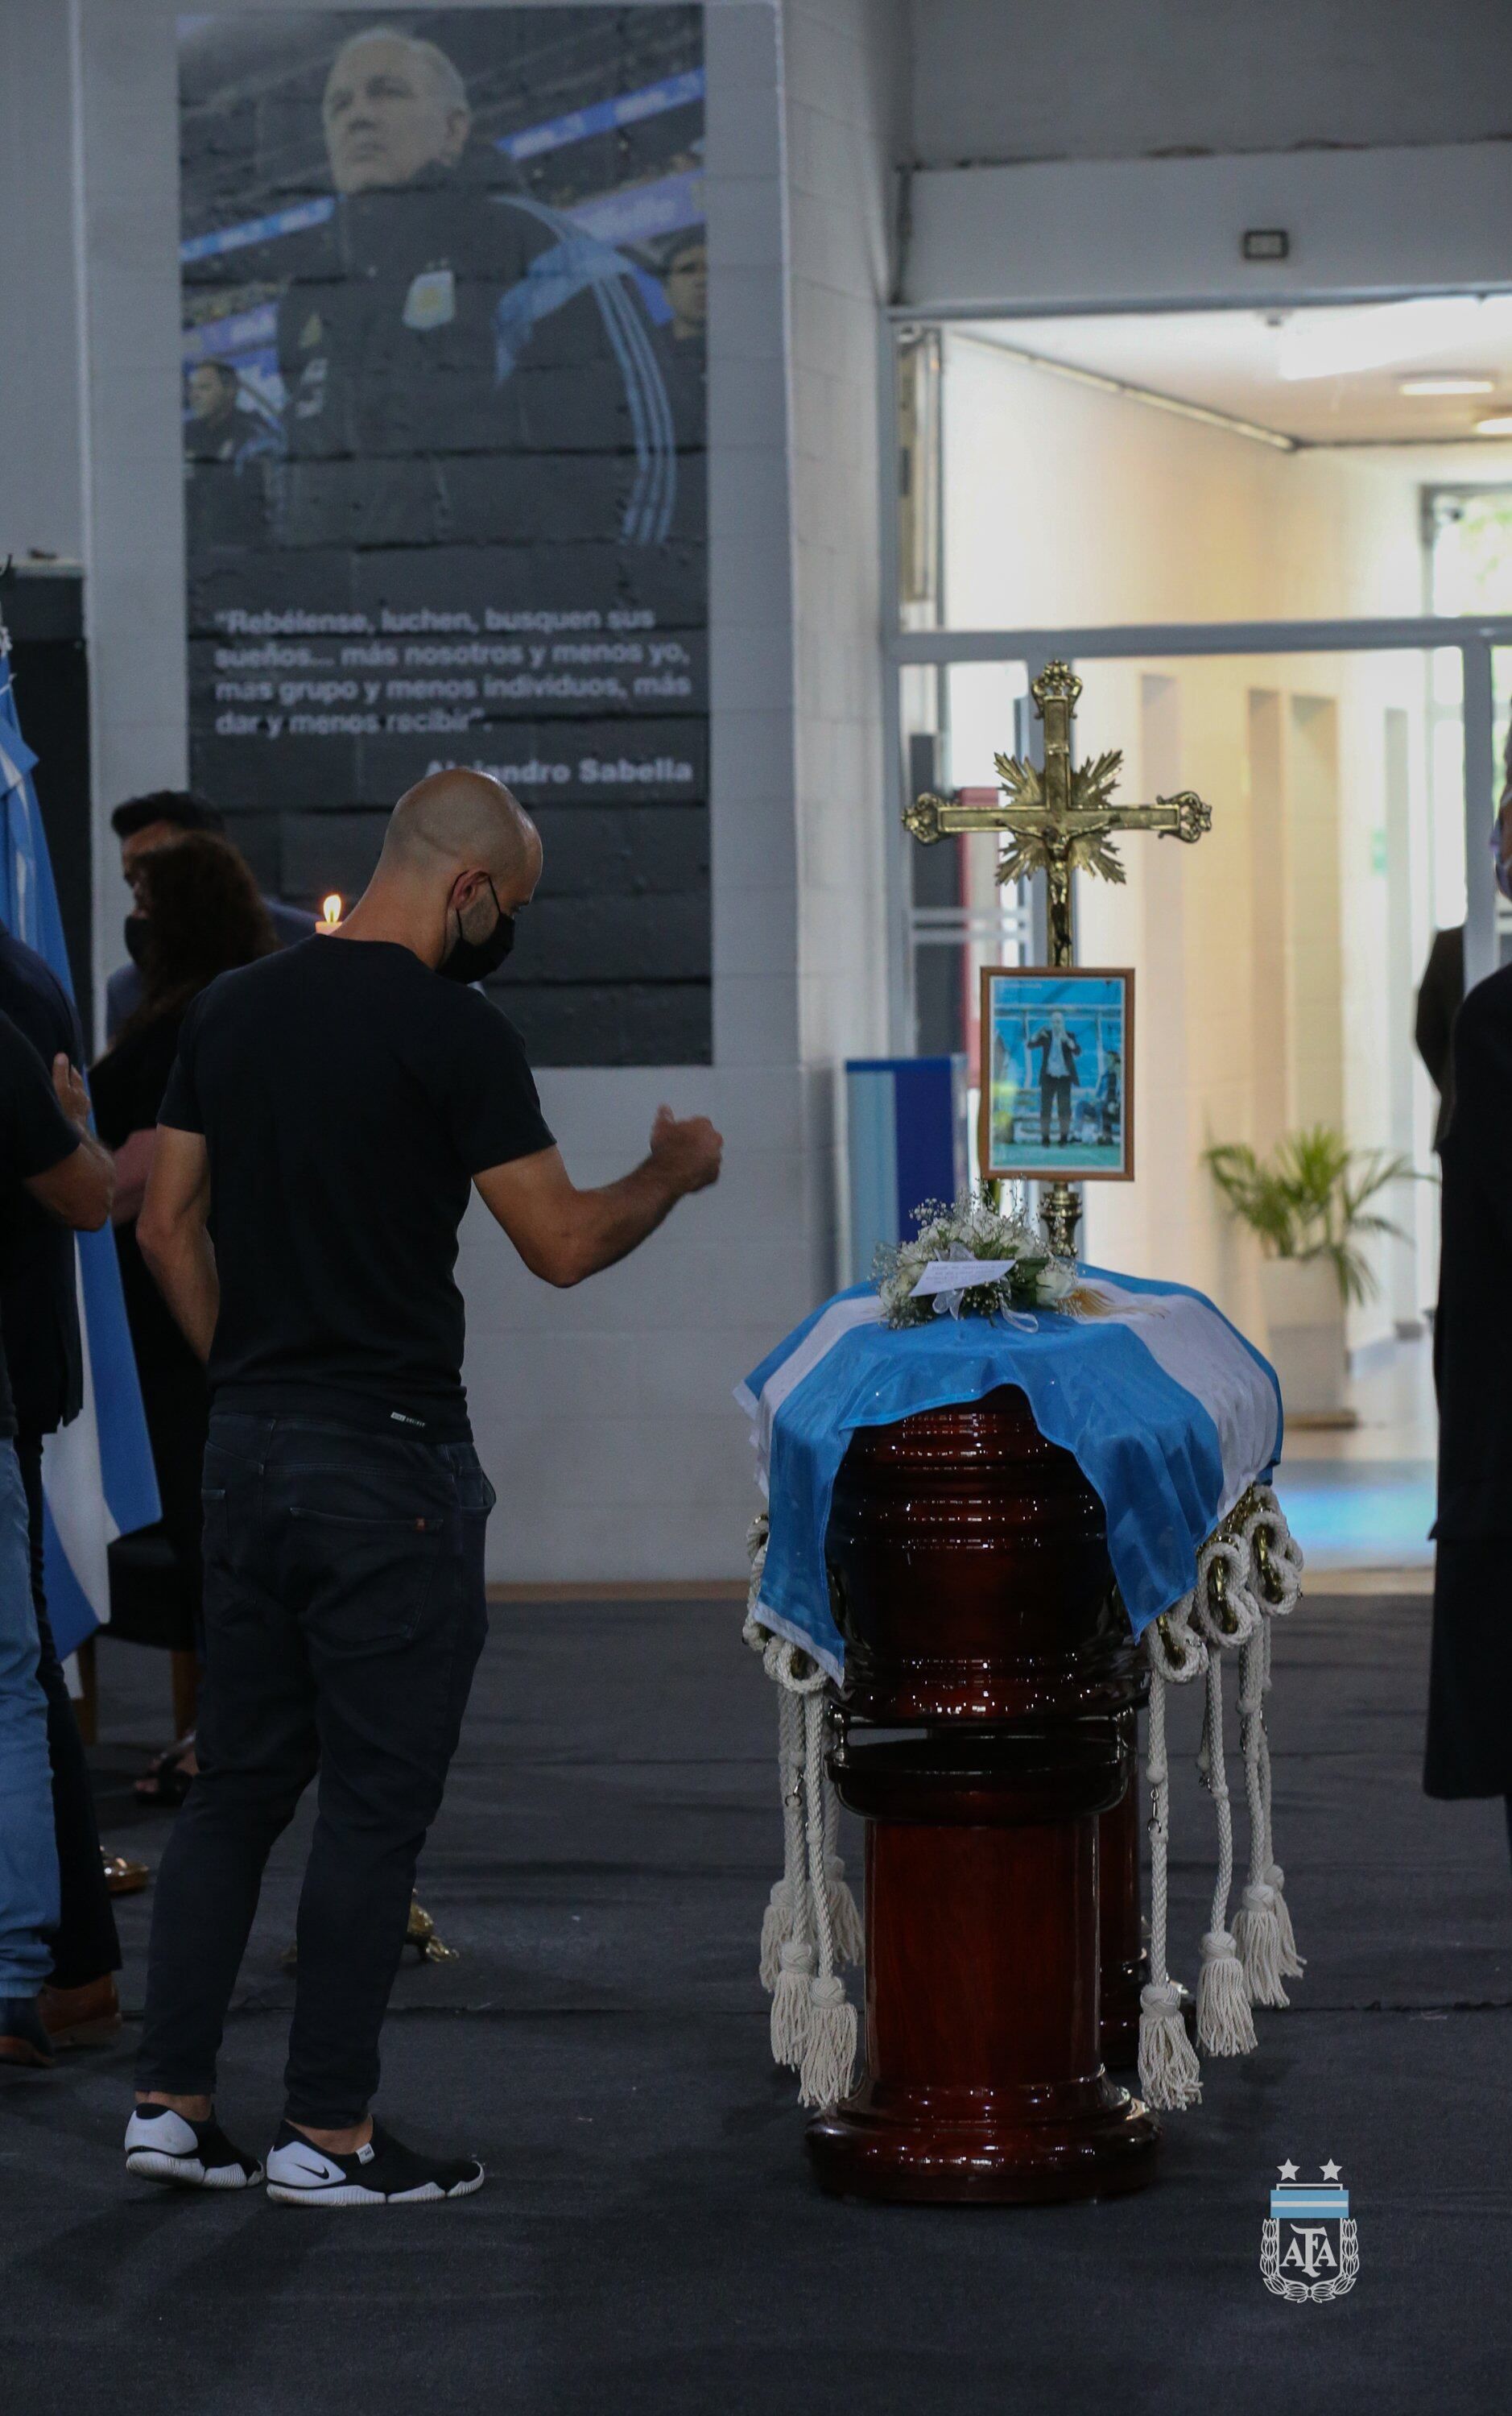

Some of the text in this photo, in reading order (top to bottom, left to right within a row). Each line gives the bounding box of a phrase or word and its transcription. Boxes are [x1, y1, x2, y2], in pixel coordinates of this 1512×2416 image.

[485, 608, 601, 634] busquen
[607, 610, 655, 630] sus
[341, 640, 399, 666] más
[405, 643, 523, 665] nosotros
[530, 647, 546, 668] y
[552, 643, 643, 664] menos
[648, 643, 690, 667] yo,
[279, 681, 358, 705] grupo
[364, 681, 381, 704] y
[386, 680, 477, 699] menos
[634, 672, 691, 696] más
[216, 712, 260, 734] dar
[267, 715, 283, 738] y
[290, 714, 380, 734] menos
[580, 759, 692, 783] Sabella
